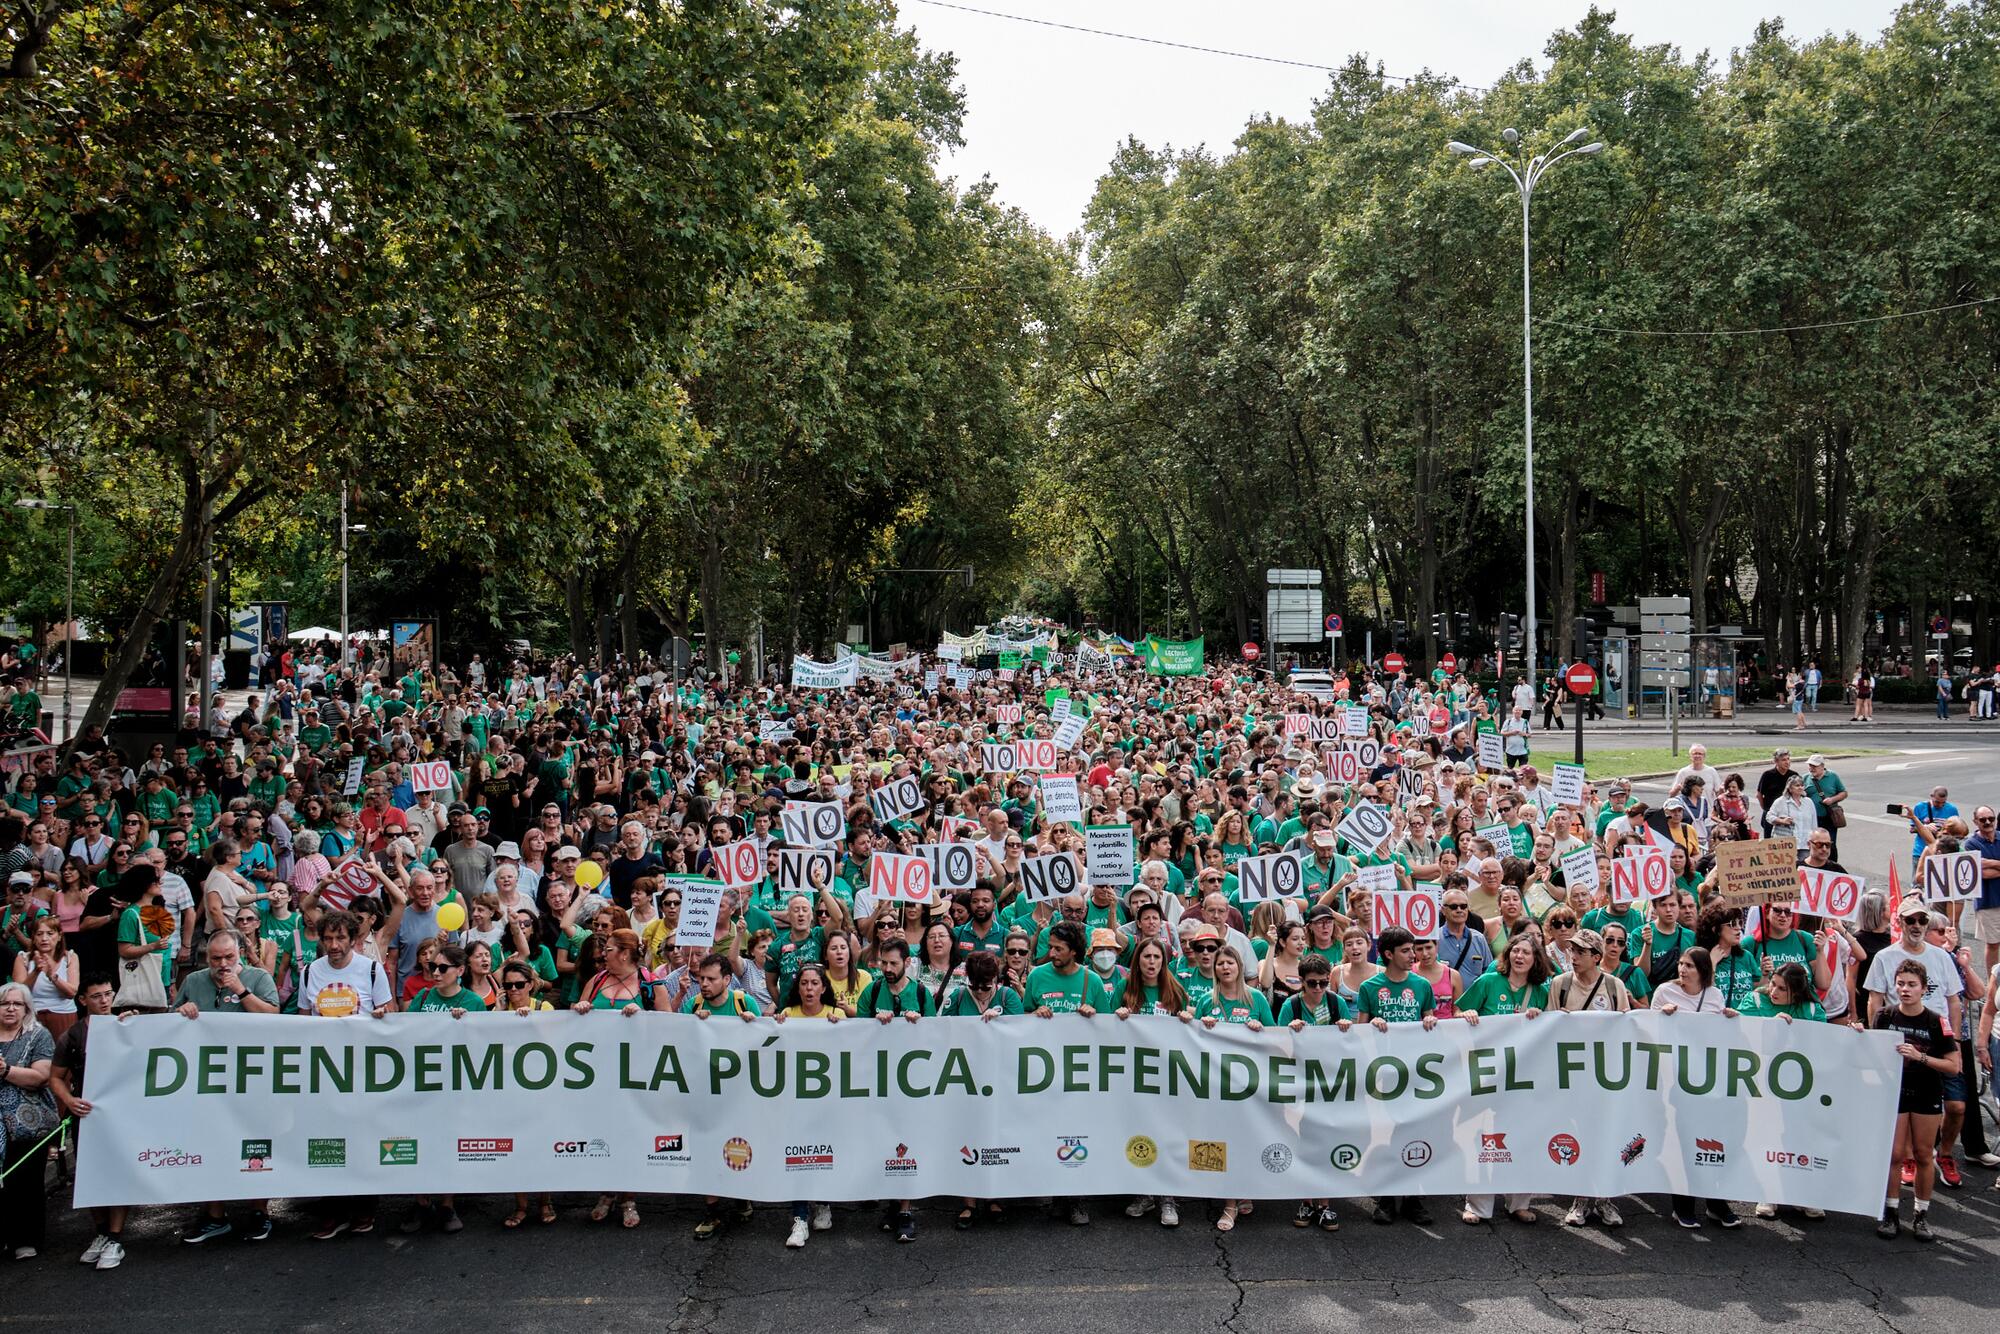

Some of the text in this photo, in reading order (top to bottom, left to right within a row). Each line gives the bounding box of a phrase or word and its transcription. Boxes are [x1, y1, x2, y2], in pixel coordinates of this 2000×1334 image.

[1048, 652, 1062, 663] NO
[978, 670, 992, 680] NO
[1001, 670, 1013, 680] NO
[897, 687, 914, 698] NO
[998, 707, 1021, 722] NO
[1287, 716, 1309, 734] NO
[1312, 720, 1338, 739] NO
[1413, 717, 1427, 734] NO
[982, 746, 1014, 771] NO
[1018, 741, 1055, 768] NO
[412, 763, 448, 789] NO
[1329, 754, 1356, 782] NO
[1401, 771, 1423, 797] NO
[877, 780, 919, 820] NO
[784, 806, 841, 844] NO
[1338, 806, 1387, 853] NO
[1098, 841, 1127, 849] plantilla,
[714, 843, 758, 885] NO
[781, 852, 832, 889] NO
[1729, 857, 1743, 868] PT
[1750, 855, 1763, 867] AL
[872, 855, 930, 899] NO
[1021, 855, 1075, 899] NO
[1242, 855, 1300, 899] NO
[1614, 855, 1667, 900] NO
[1755, 867, 1792, 877] EDUCATIVO
[1927, 855, 1978, 899] NO
[321, 861, 378, 911] NO
[688, 885, 713, 893] Maestros
[1794, 870, 1858, 917] NO
[692, 897, 716, 905] plantilla,
[1375, 894, 1435, 937] NO
[145, 1036, 1833, 1106] DEFENDEMOS LA PÚBLICA. DEFENDEMOS EL FUTURO.
[460, 1141, 496, 1150] CCOO
[554, 1141, 587, 1153] CGT
[658, 1139, 679, 1148] CNT
[785, 1145, 833, 1155] CONFAPA
[138, 1147, 172, 1162] abrir
[1696, 1152, 1725, 1163] STEM
[1767, 1151, 1795, 1164] UGT
